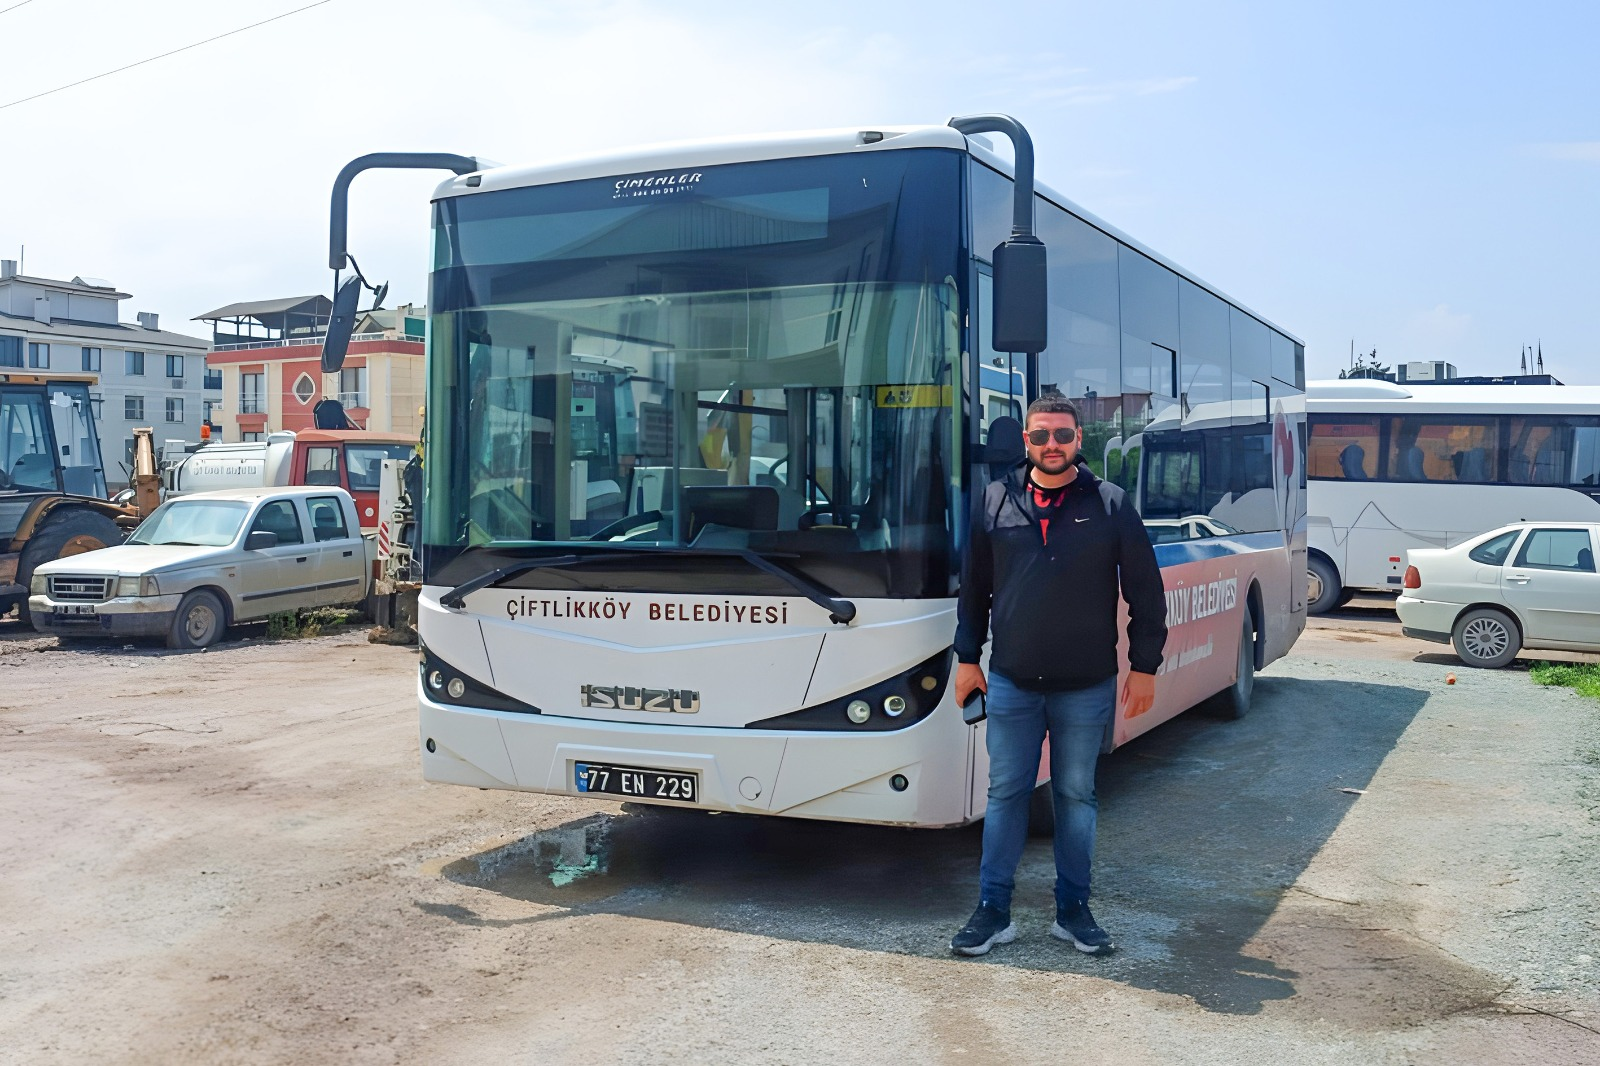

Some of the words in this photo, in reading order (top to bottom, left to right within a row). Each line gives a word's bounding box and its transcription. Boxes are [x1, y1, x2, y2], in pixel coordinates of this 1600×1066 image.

[506, 596, 631, 620] ÇİFTLİKKÖY
[649, 600, 788, 625] BELEDİYESİ
[581, 684, 700, 714] ISUZU
[588, 770, 609, 791] 77
[621, 773, 644, 794] EN
[656, 776, 692, 799] 229
